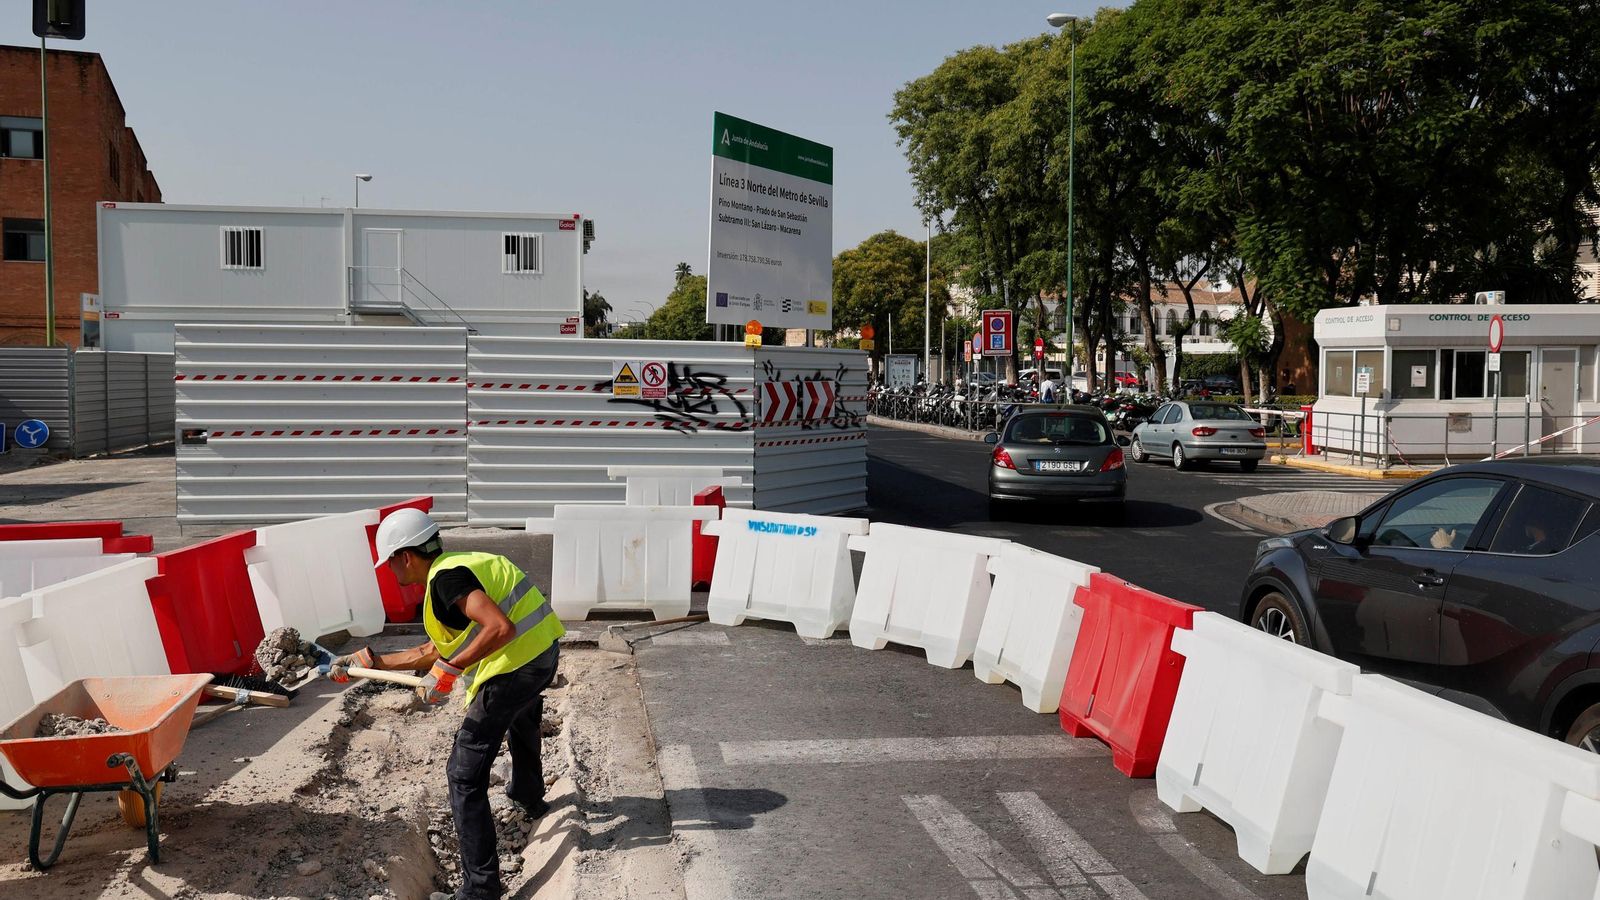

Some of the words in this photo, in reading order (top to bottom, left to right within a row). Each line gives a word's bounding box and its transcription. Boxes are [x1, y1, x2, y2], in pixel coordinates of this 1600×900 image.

[732, 134, 742, 144] Junta
[720, 172, 739, 187] Línea
[741, 178, 745, 190] 3
[747, 180, 766, 194] Norte
[768, 184, 778, 198] del
[780, 188, 798, 202] Metro
[800, 192, 808, 204] de
[808, 194, 828, 208] Sevilla
[718, 198, 730, 208] Pino
[732, 200, 753, 212] Montano
[756, 206, 770, 216] Prado
[771, 208, 777, 217] de
[778, 210, 786, 218] San
[787, 211, 808, 222] Sebastián
[718, 214, 743, 226] Subtramo
[752, 220, 760, 228] San
[762, 221, 776, 232] Lázaro
[780, 225, 801, 236] Macarena
[1326, 316, 1345, 324] CONTROL
[1429, 314, 1472, 322] CONTROL
